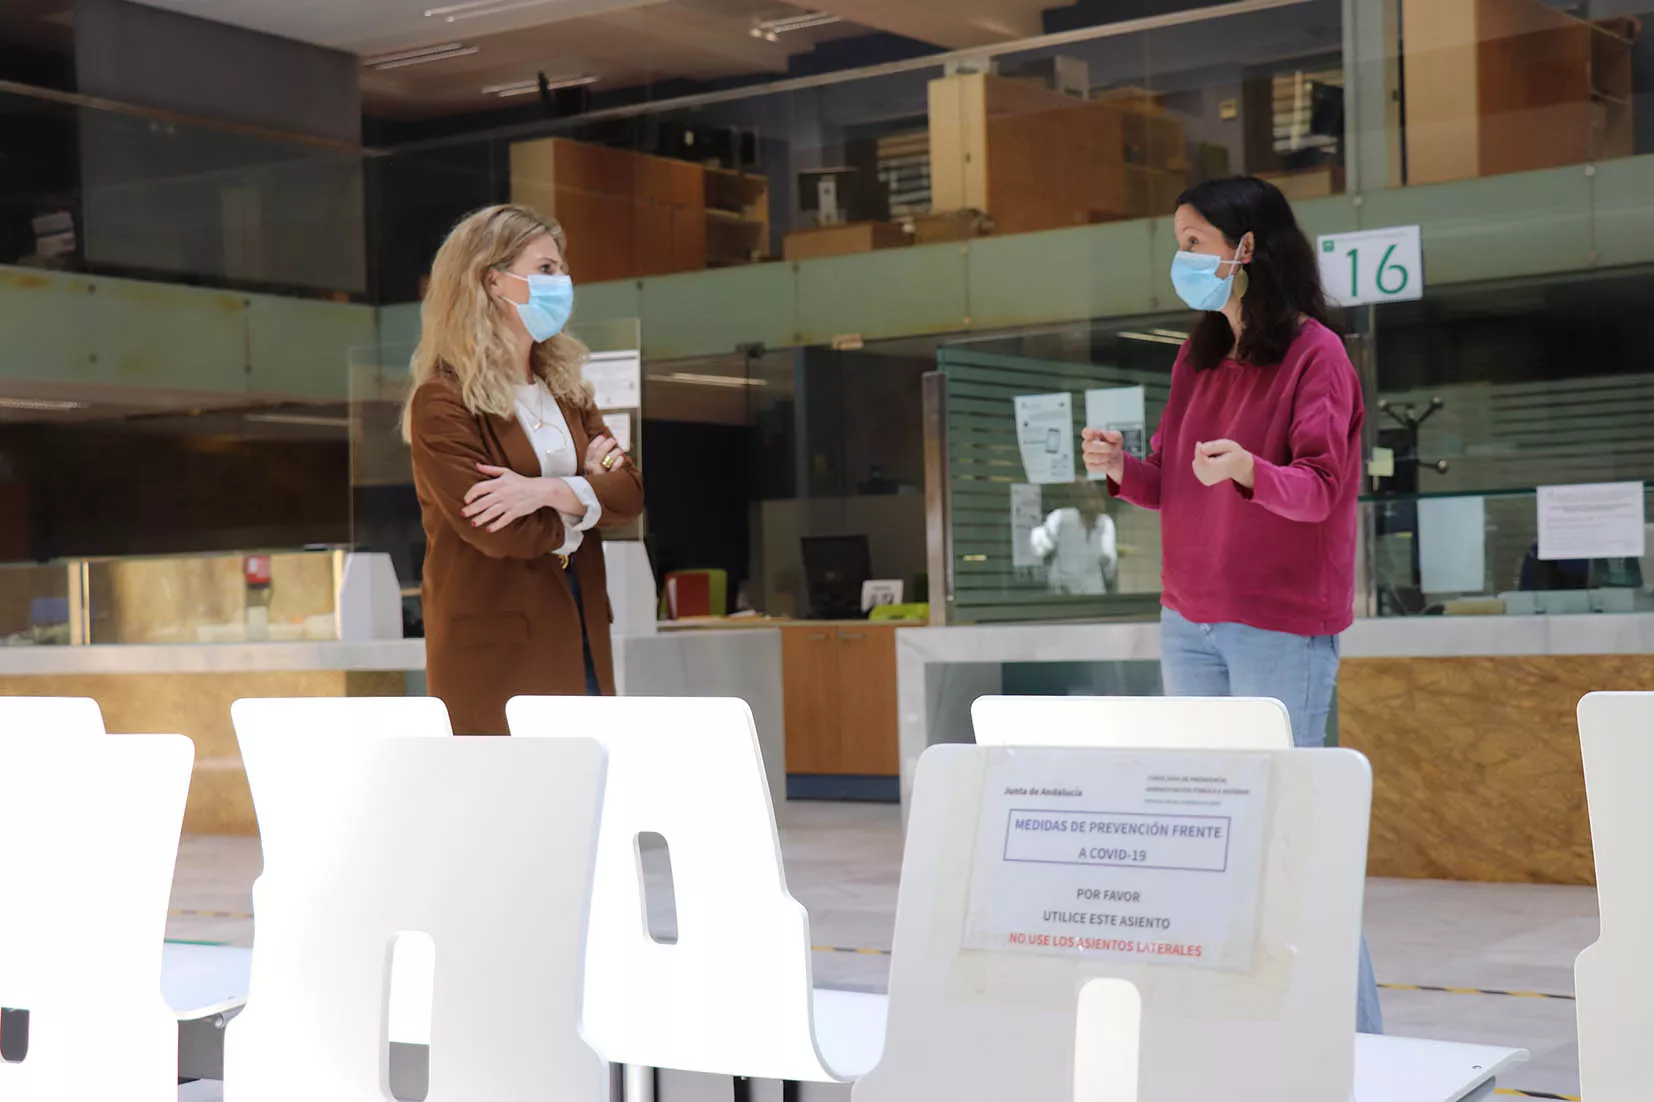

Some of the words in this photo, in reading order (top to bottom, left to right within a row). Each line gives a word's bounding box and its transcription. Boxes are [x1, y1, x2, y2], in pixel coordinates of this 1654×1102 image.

[1345, 243, 1409, 298] 16
[1004, 786, 1027, 796] Junta
[1029, 787, 1040, 796] de
[1015, 818, 1068, 832] MEDIDAS
[1070, 820, 1086, 833] DE
[1089, 821, 1169, 837] PREVENCIÓN
[1172, 824, 1222, 839] FRENTE
[1078, 847, 1088, 859] A
[1089, 848, 1147, 862] COVID-19
[1076, 888, 1101, 900] POR
[1103, 889, 1140, 902] FAVOR
[1043, 910, 1087, 924] UTILICE
[1089, 913, 1117, 926] ESTE
[1119, 915, 1170, 930] ASIENTO
[1009, 932, 1026, 945] NO
[1028, 934, 1050, 946] USE
[1053, 935, 1075, 948] LOS
[1077, 936, 1134, 952] ASIENTOS
[1136, 941, 1203, 957] LATERALES
